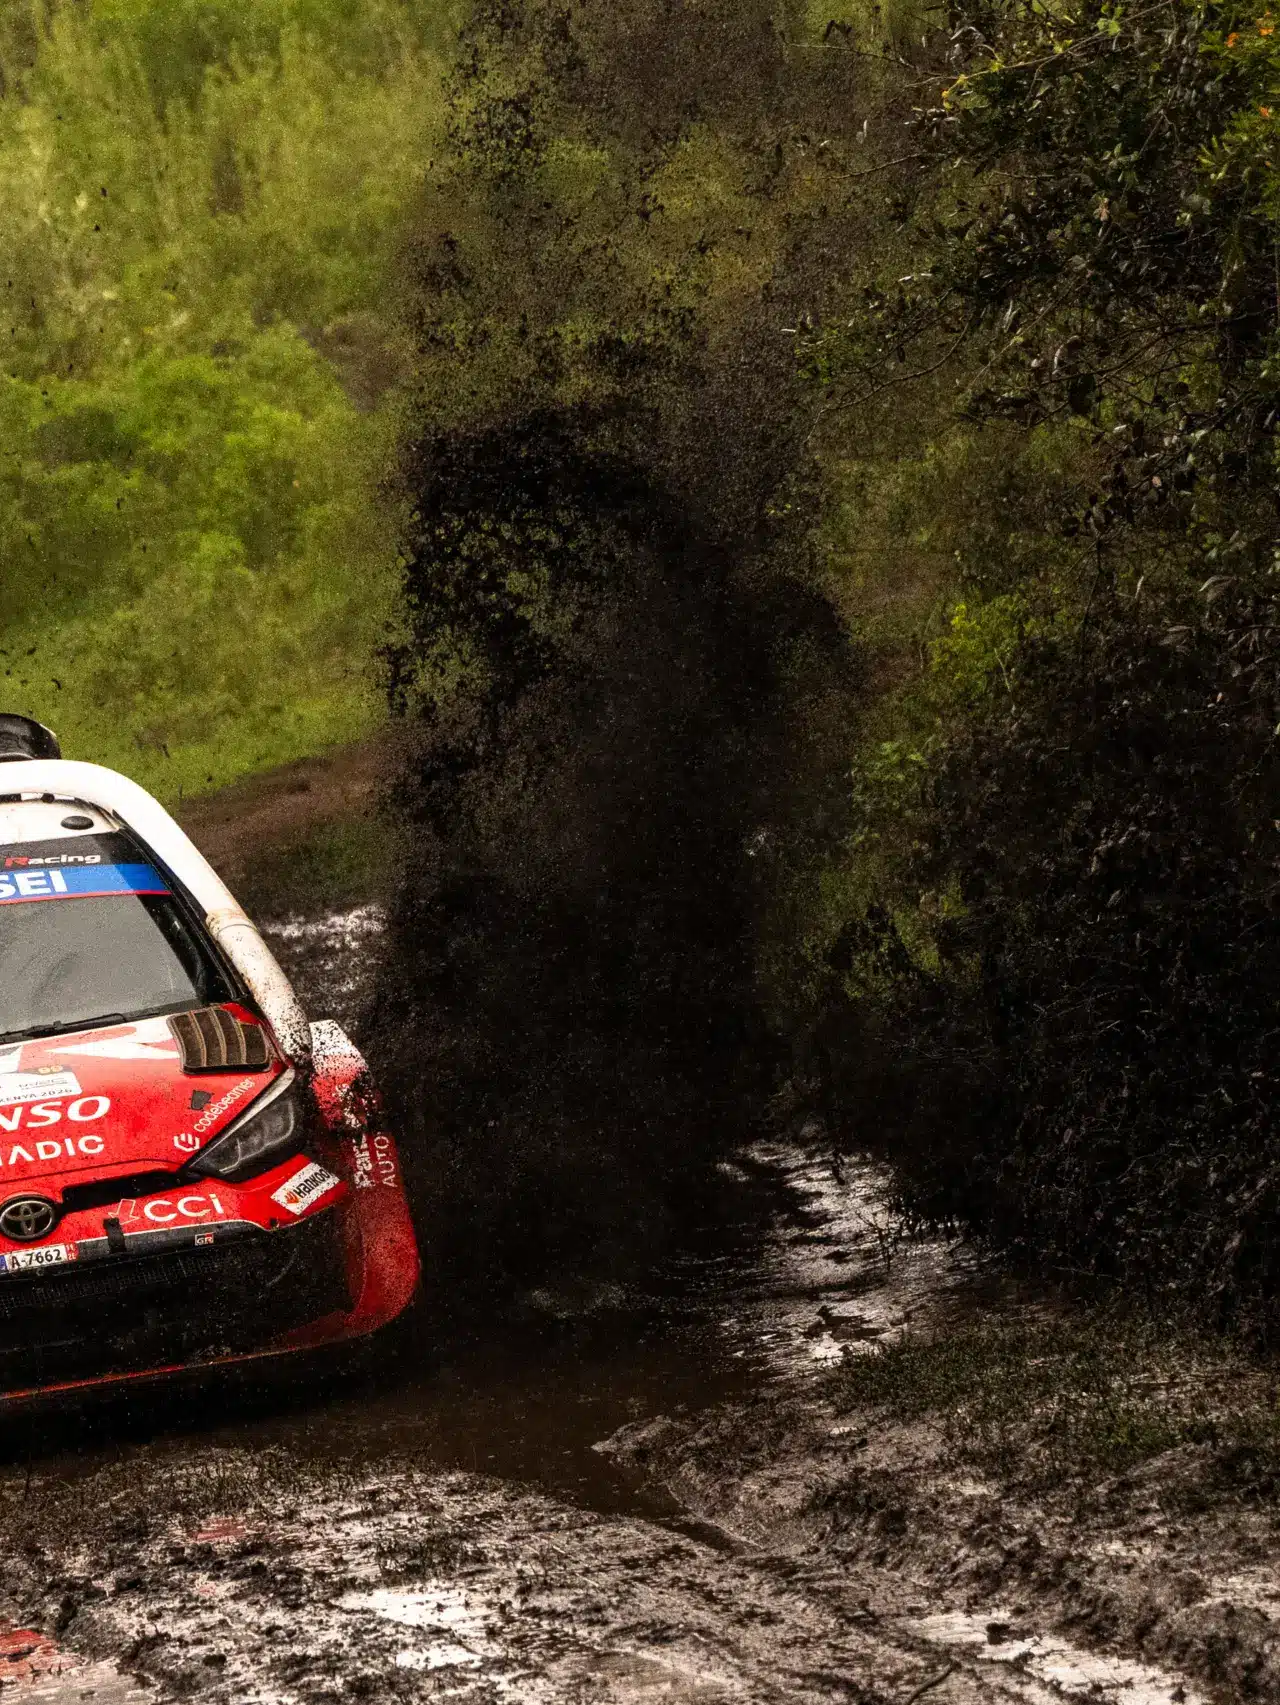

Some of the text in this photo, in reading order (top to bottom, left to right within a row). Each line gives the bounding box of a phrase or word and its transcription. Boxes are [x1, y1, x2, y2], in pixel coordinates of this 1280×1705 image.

[4, 854, 101, 868] Racing
[193, 1077, 255, 1133] codebeamer
[196, 1235, 214, 1246] GR
[11, 1249, 62, 1268] A-7662
